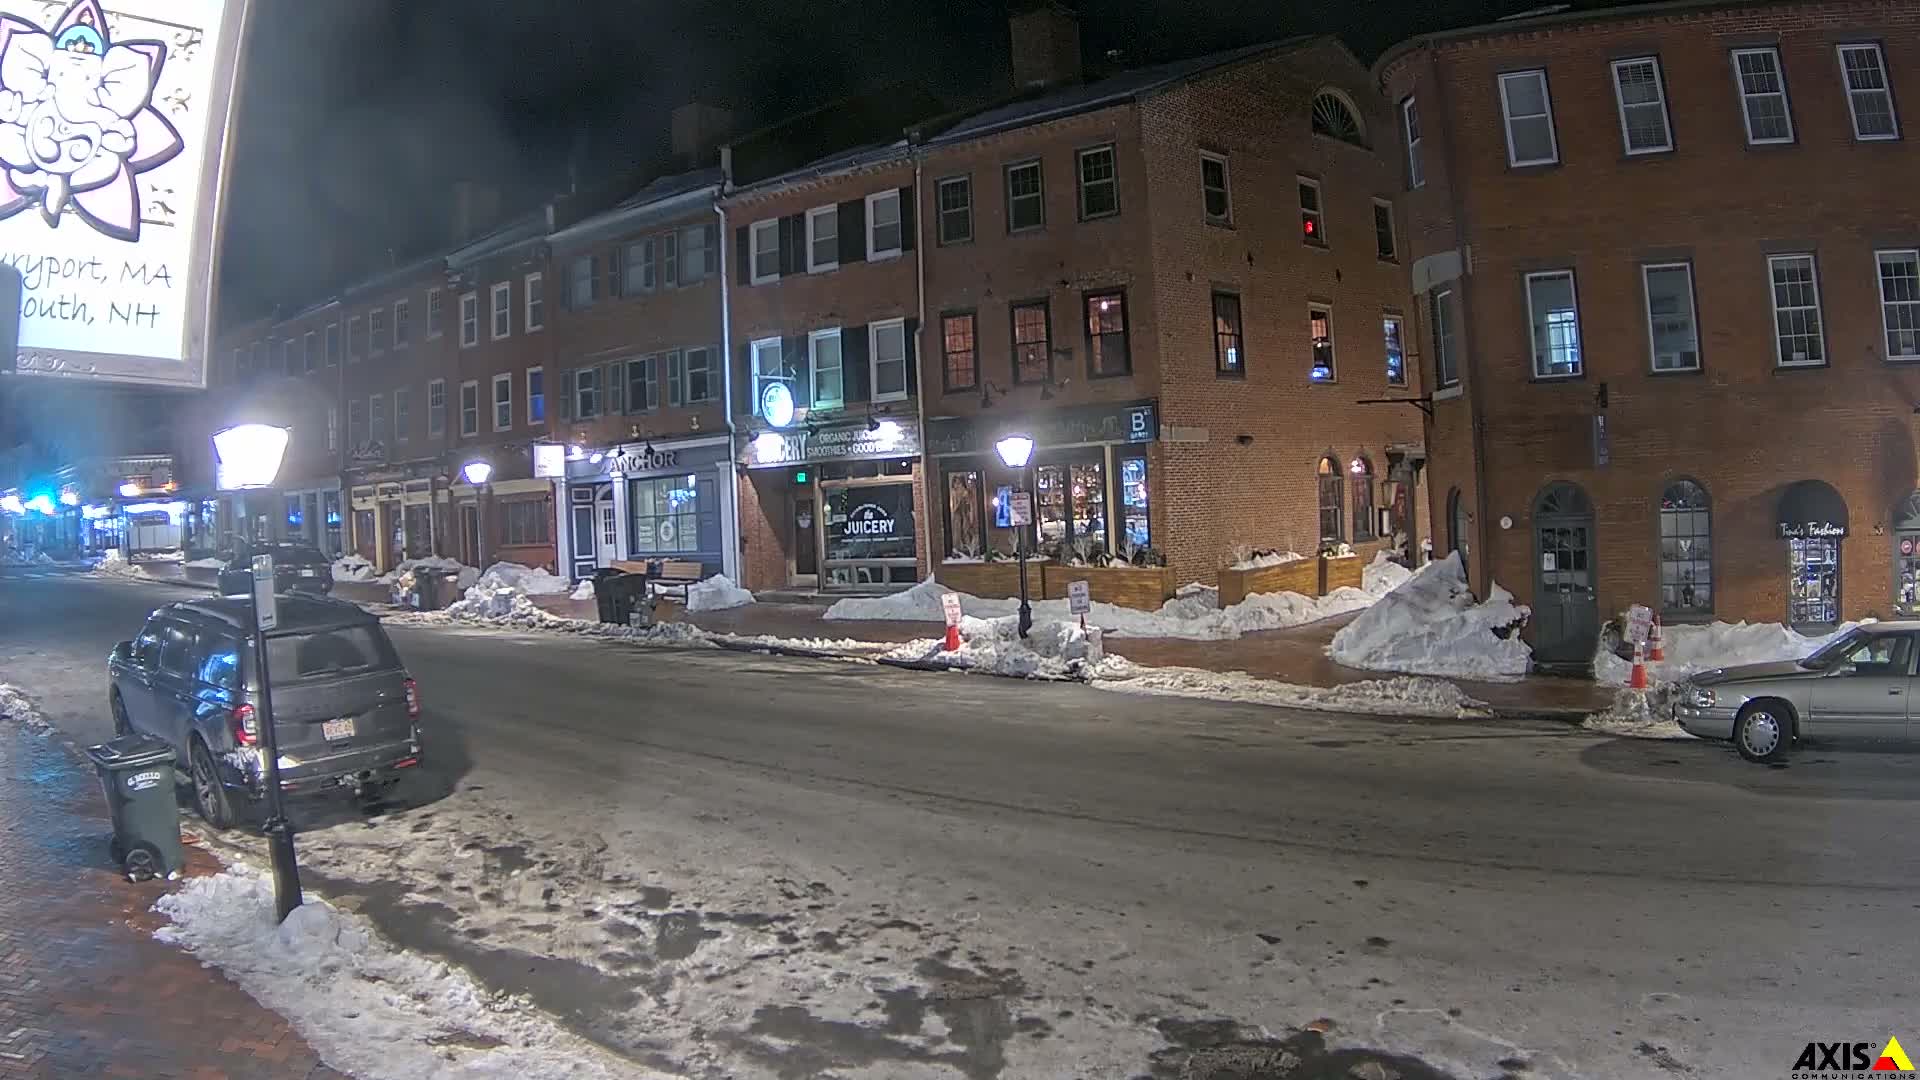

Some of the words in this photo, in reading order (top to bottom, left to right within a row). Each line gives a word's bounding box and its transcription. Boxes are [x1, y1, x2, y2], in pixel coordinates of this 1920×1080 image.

[120, 260, 172, 288] MA
[23, 293, 95, 326] outh,
[109, 301, 160, 328] NH
[819, 432, 851, 444] ORGANIC
[609, 451, 678, 473] ANCHOR
[843, 519, 895, 535] JUICERY
